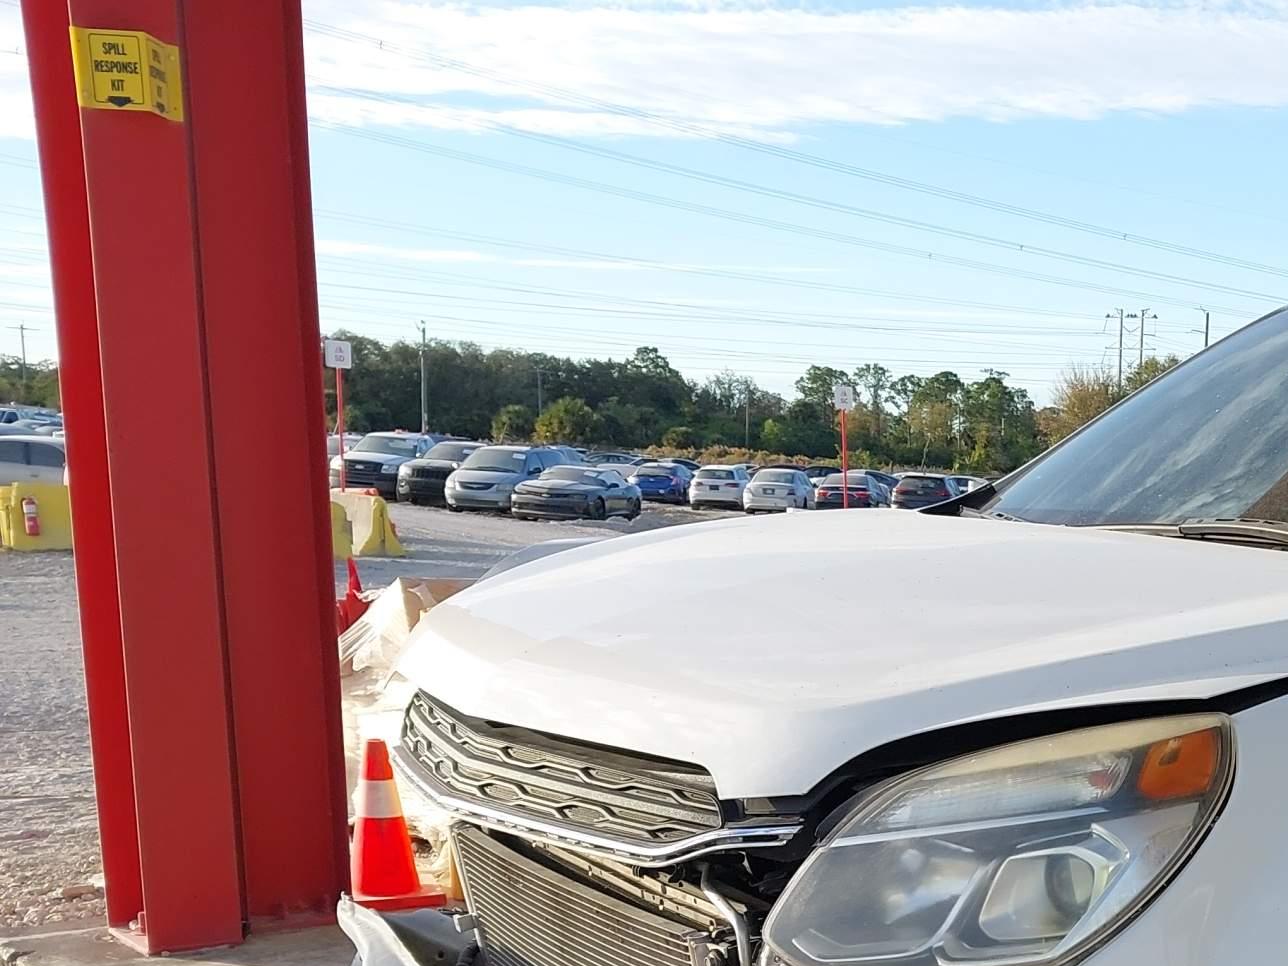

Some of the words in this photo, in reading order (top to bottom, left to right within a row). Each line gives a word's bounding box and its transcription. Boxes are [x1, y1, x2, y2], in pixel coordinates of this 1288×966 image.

[102, 42, 127, 56] SPILL
[94, 60, 139, 74] RESPONSE
[111, 79, 124, 92] KIT
